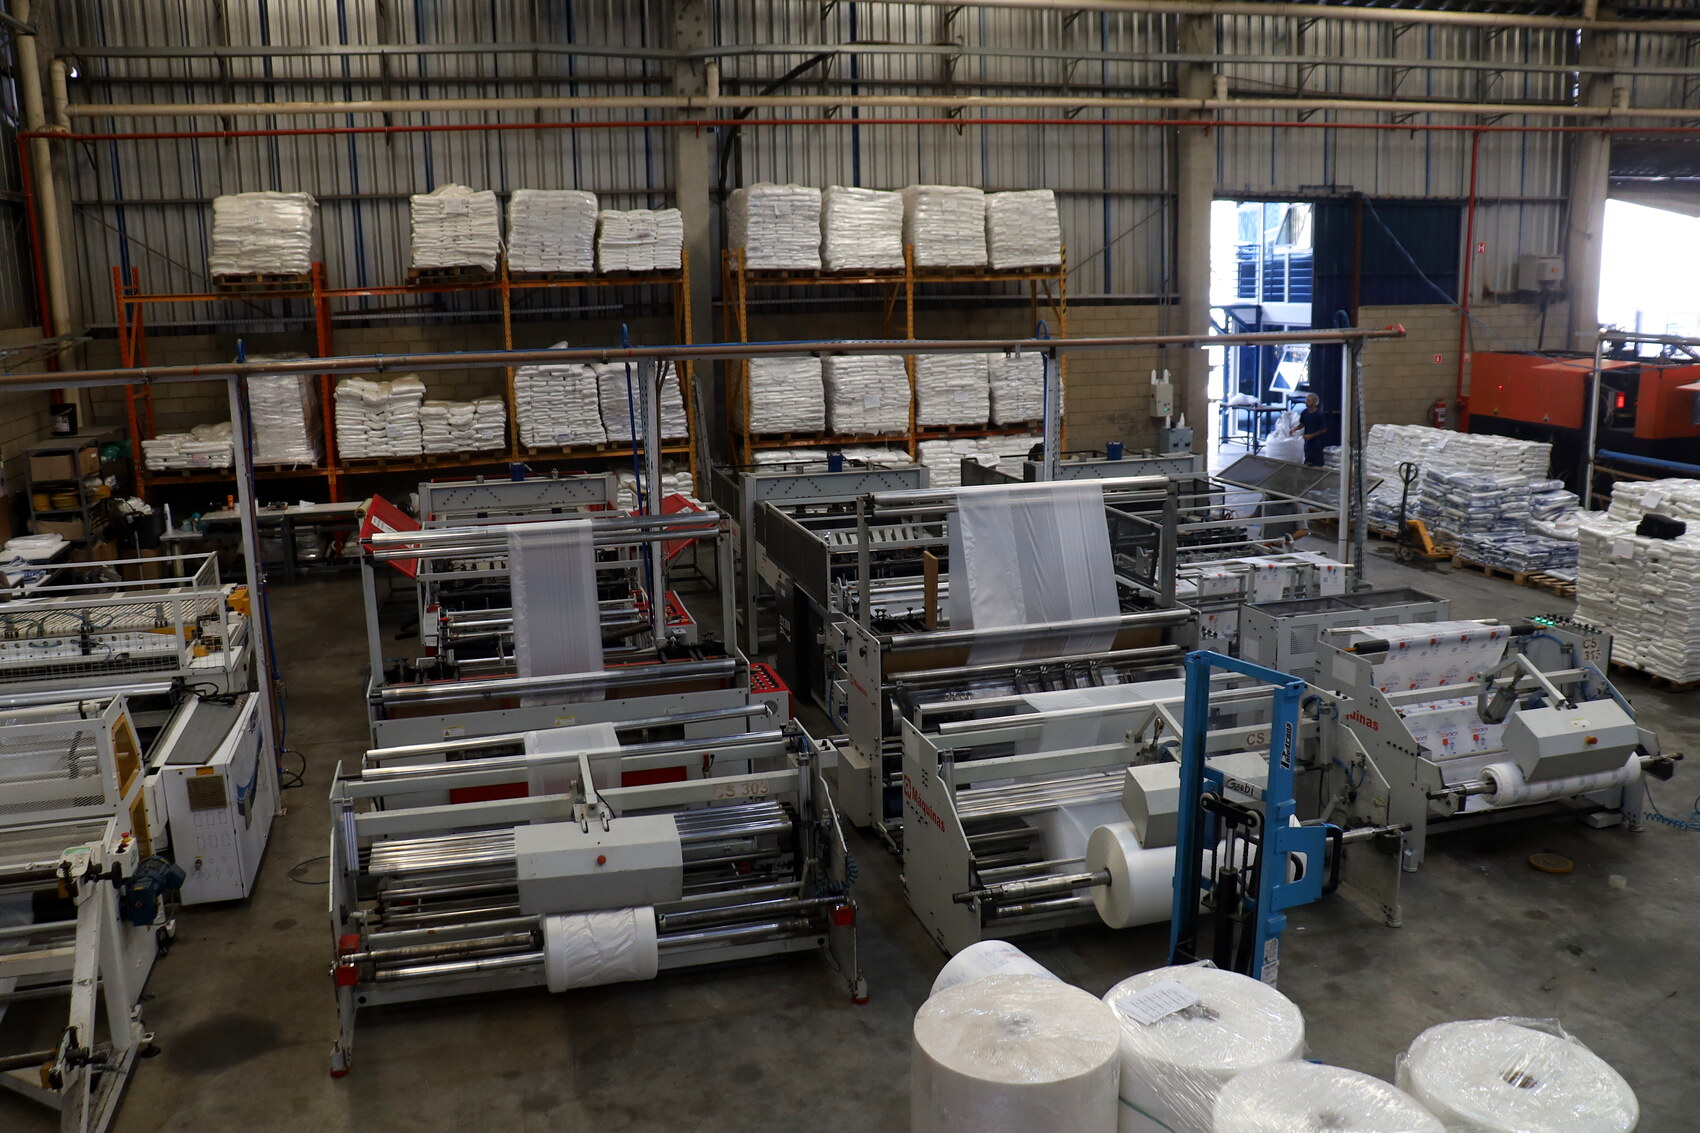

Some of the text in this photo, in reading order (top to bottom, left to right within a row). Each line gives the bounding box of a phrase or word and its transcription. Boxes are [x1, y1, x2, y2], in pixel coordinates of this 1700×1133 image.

[1478, 243, 1485, 253] H
[1246, 732, 1265, 746] CS
[741, 780, 769, 796] 303
